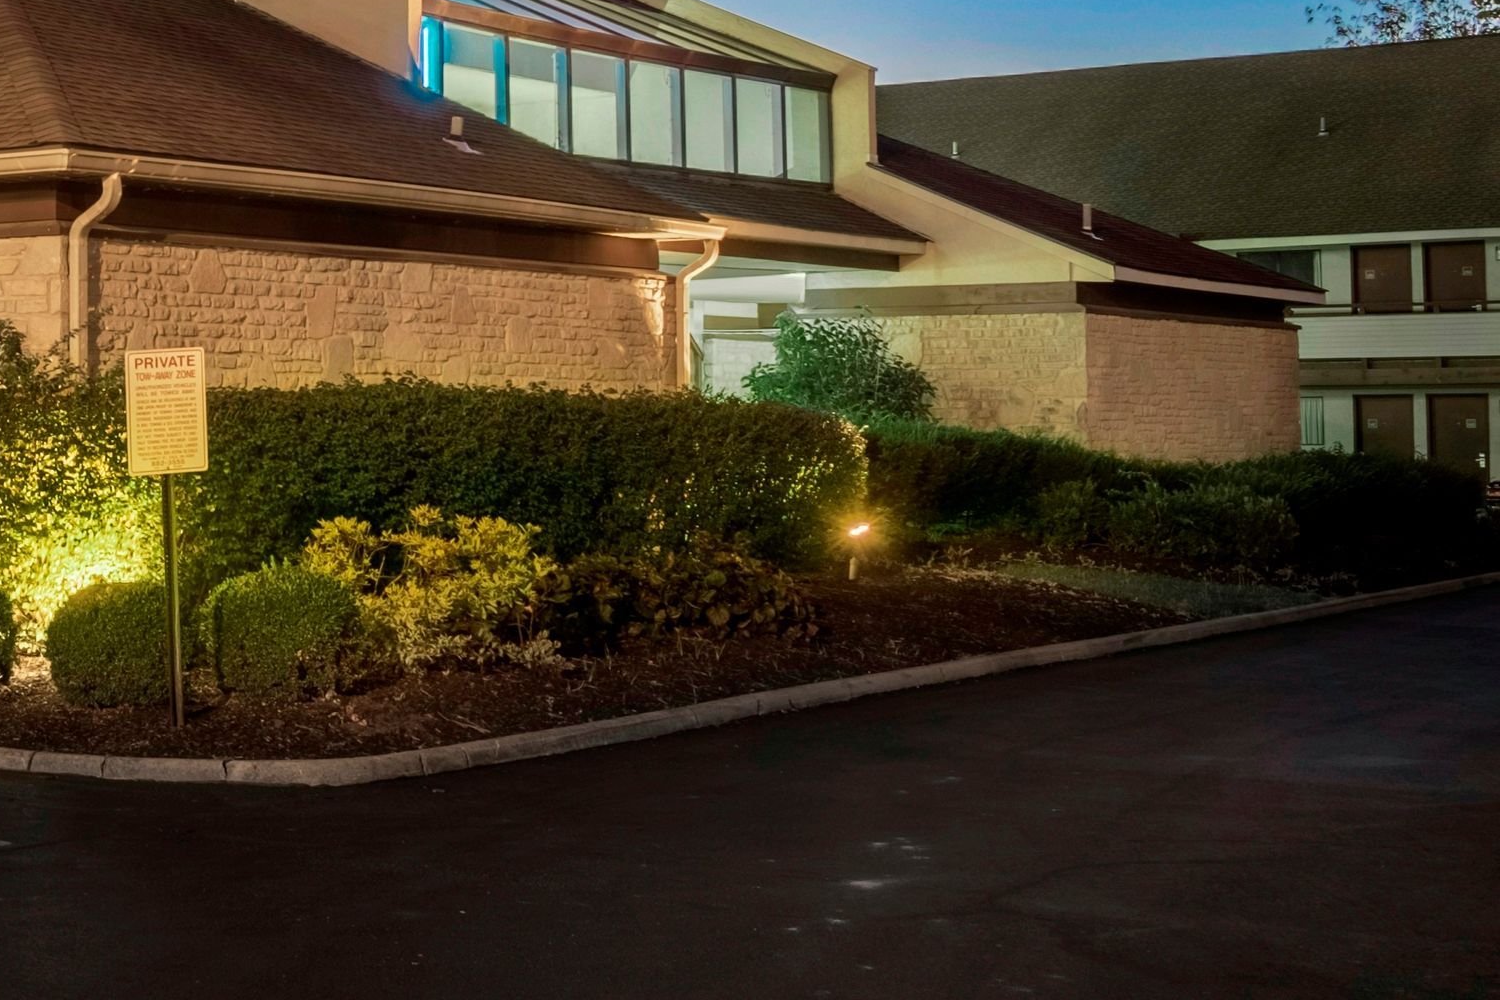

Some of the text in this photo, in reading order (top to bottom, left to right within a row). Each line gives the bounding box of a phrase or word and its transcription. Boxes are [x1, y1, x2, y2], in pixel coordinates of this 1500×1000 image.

[134, 355, 196, 370] PRIVATE
[135, 369, 196, 381] TOW-AWAY ZONE
